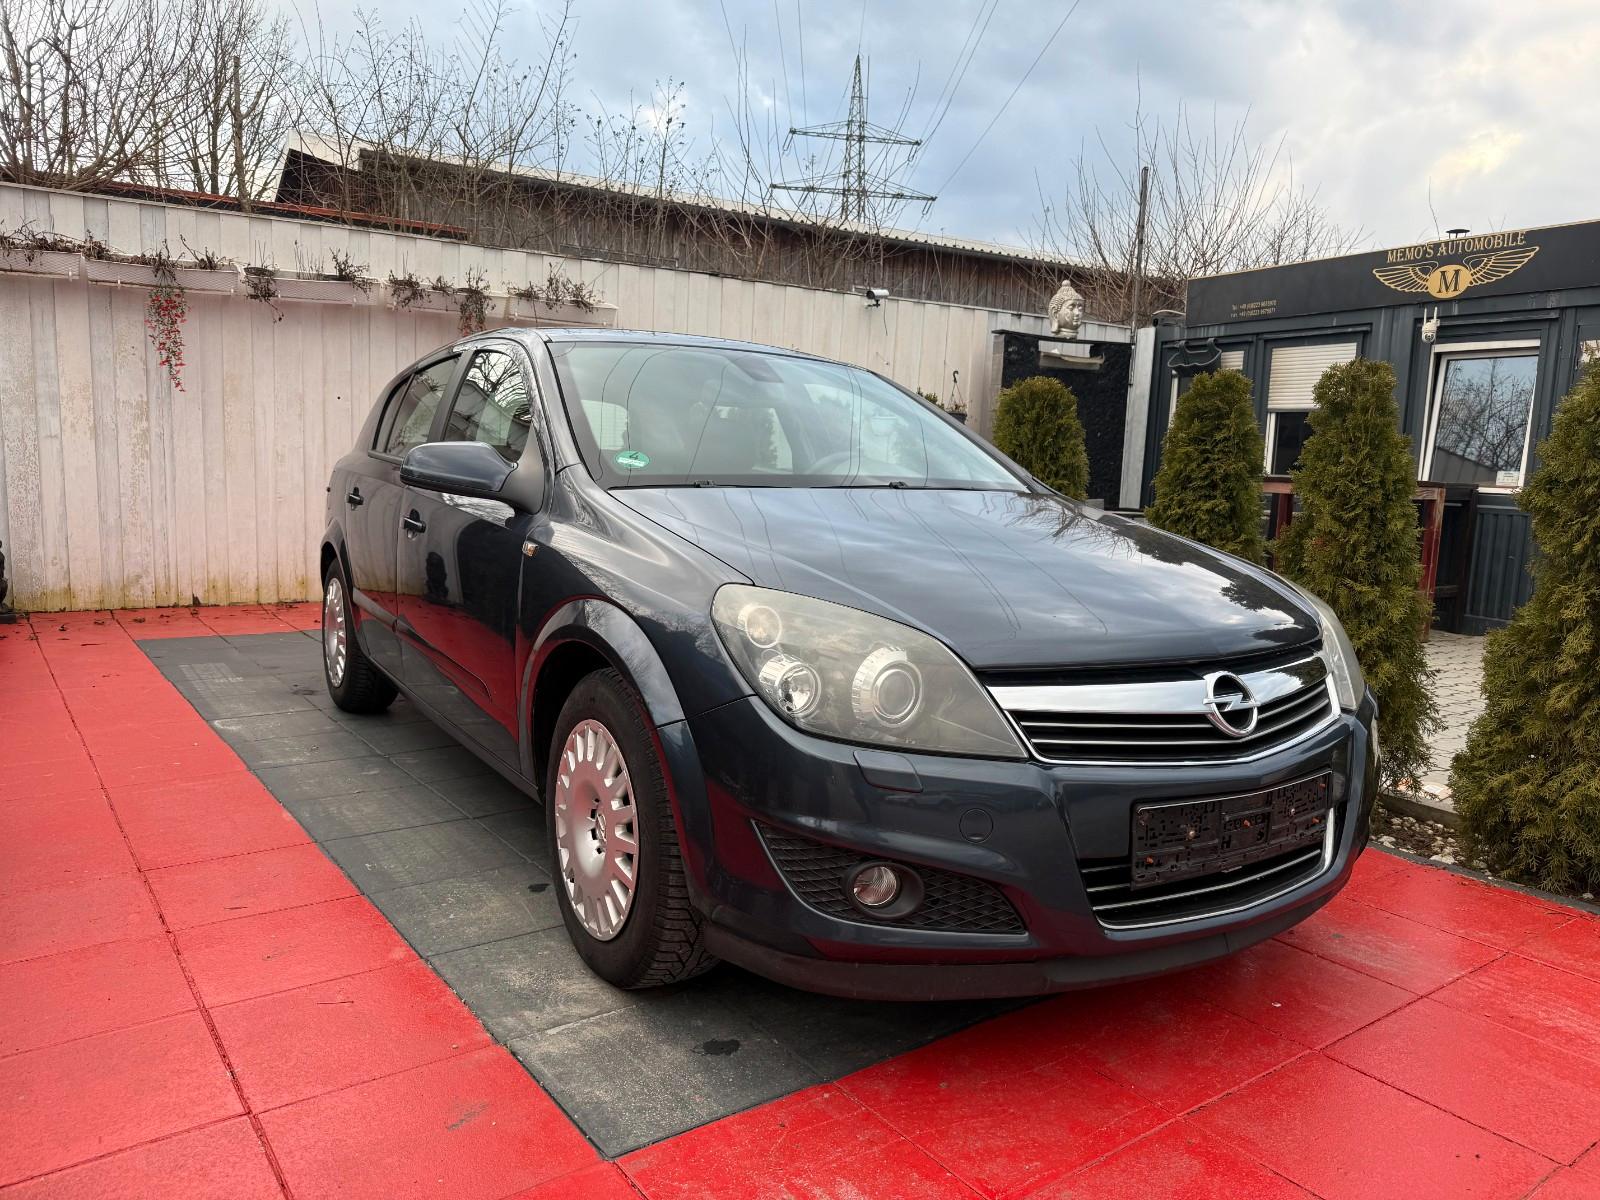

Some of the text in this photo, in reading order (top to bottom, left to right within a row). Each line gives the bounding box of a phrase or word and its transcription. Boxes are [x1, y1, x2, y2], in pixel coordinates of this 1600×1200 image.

[1387, 231, 1526, 264] MEMO'S AUTOMOBILE
[1437, 268, 1462, 294] M
[629, 451, 639, 460] 4
